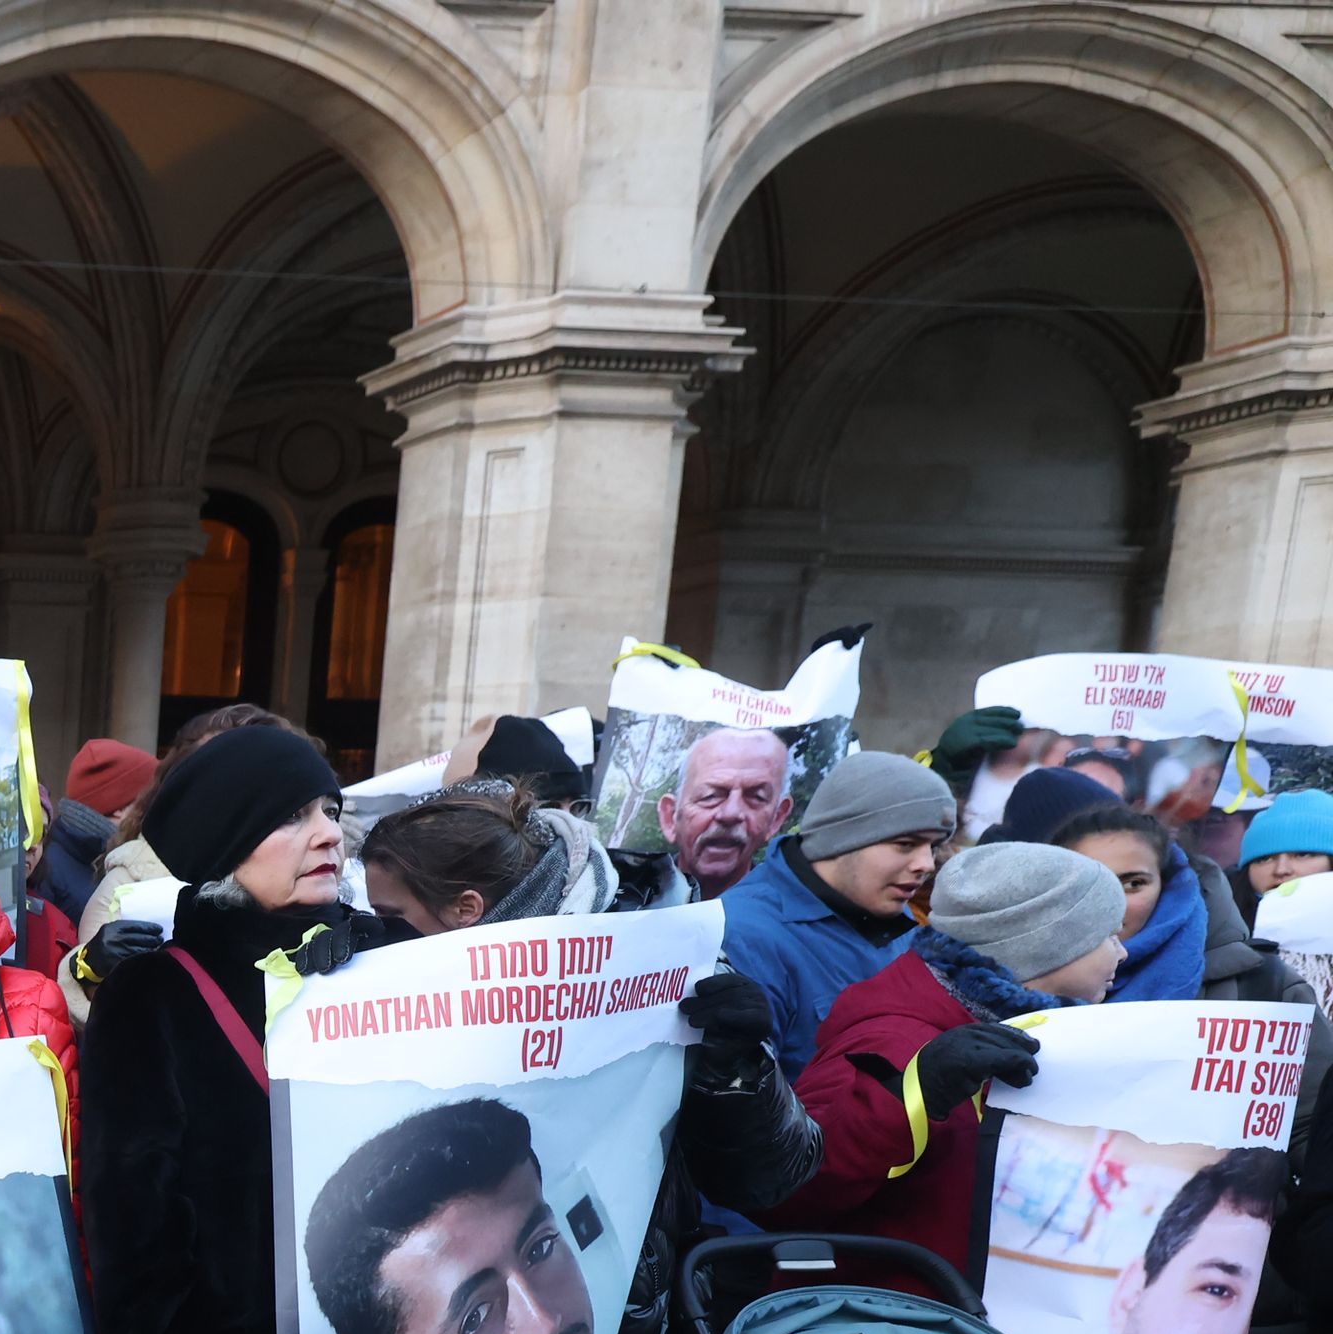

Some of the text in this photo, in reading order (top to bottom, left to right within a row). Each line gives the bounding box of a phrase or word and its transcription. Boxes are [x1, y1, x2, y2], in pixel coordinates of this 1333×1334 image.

[1144, 665, 1166, 685] אלי
[1085, 687, 1166, 710] ELI SHARABI
[1111, 709, 1134, 731] (51)
[467, 935, 613, 982] יונתן סמרנו
[306, 965, 690, 1043] YONATHAN MORDECHAI SAMERANO
[521, 1026, 563, 1073] (21)
[1197, 1017, 1302, 1056] סבירסקי
[1191, 1057, 1303, 1097] ITAI SVIRS
[1242, 1100, 1286, 1141] (38)
